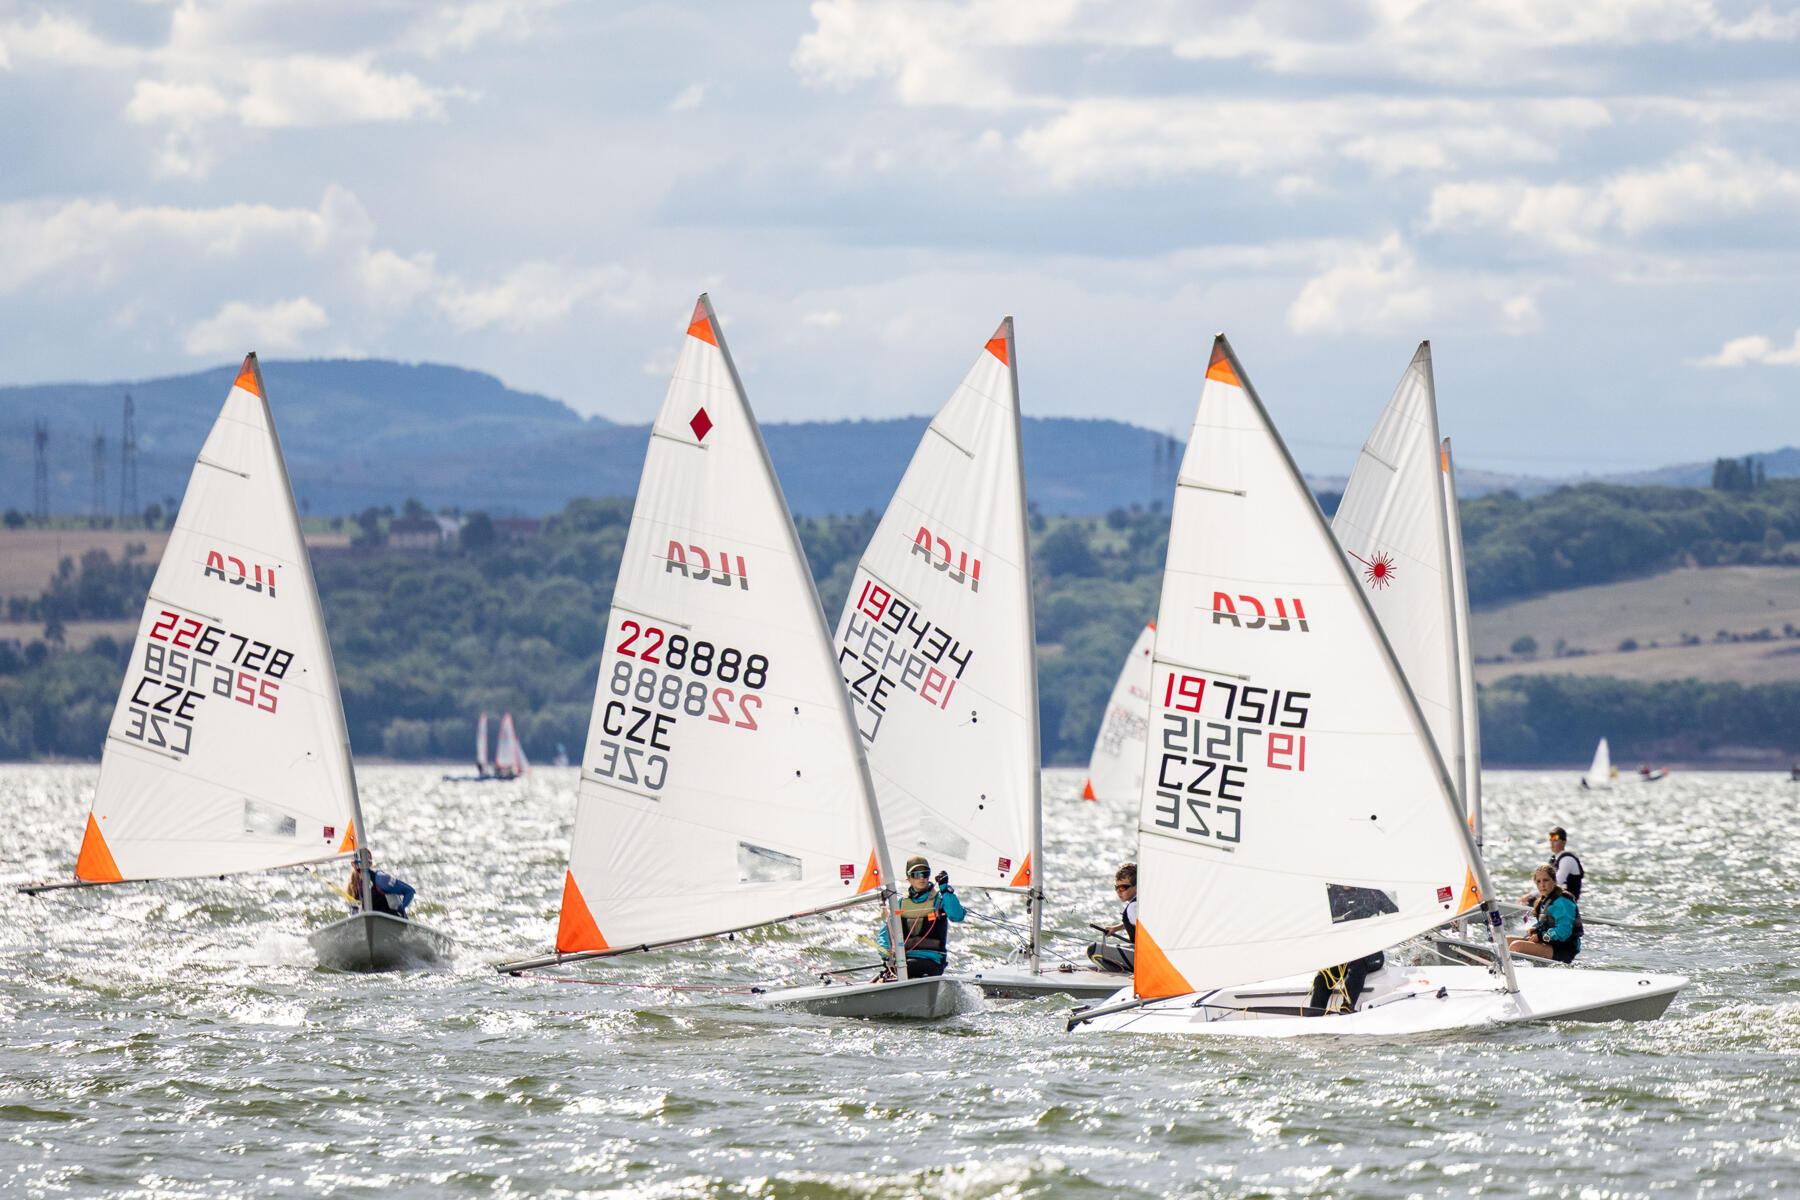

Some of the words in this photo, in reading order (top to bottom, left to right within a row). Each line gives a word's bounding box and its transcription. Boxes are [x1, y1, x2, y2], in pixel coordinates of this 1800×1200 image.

[149, 610, 295, 679] 226728
[616, 620, 769, 689] 228888
[856, 580, 973, 679] 199434
[130, 676, 206, 721] CZE
[603, 700, 677, 752] CZE
[1164, 673, 1312, 728] 197515
[1158, 753, 1248, 802] CZE
